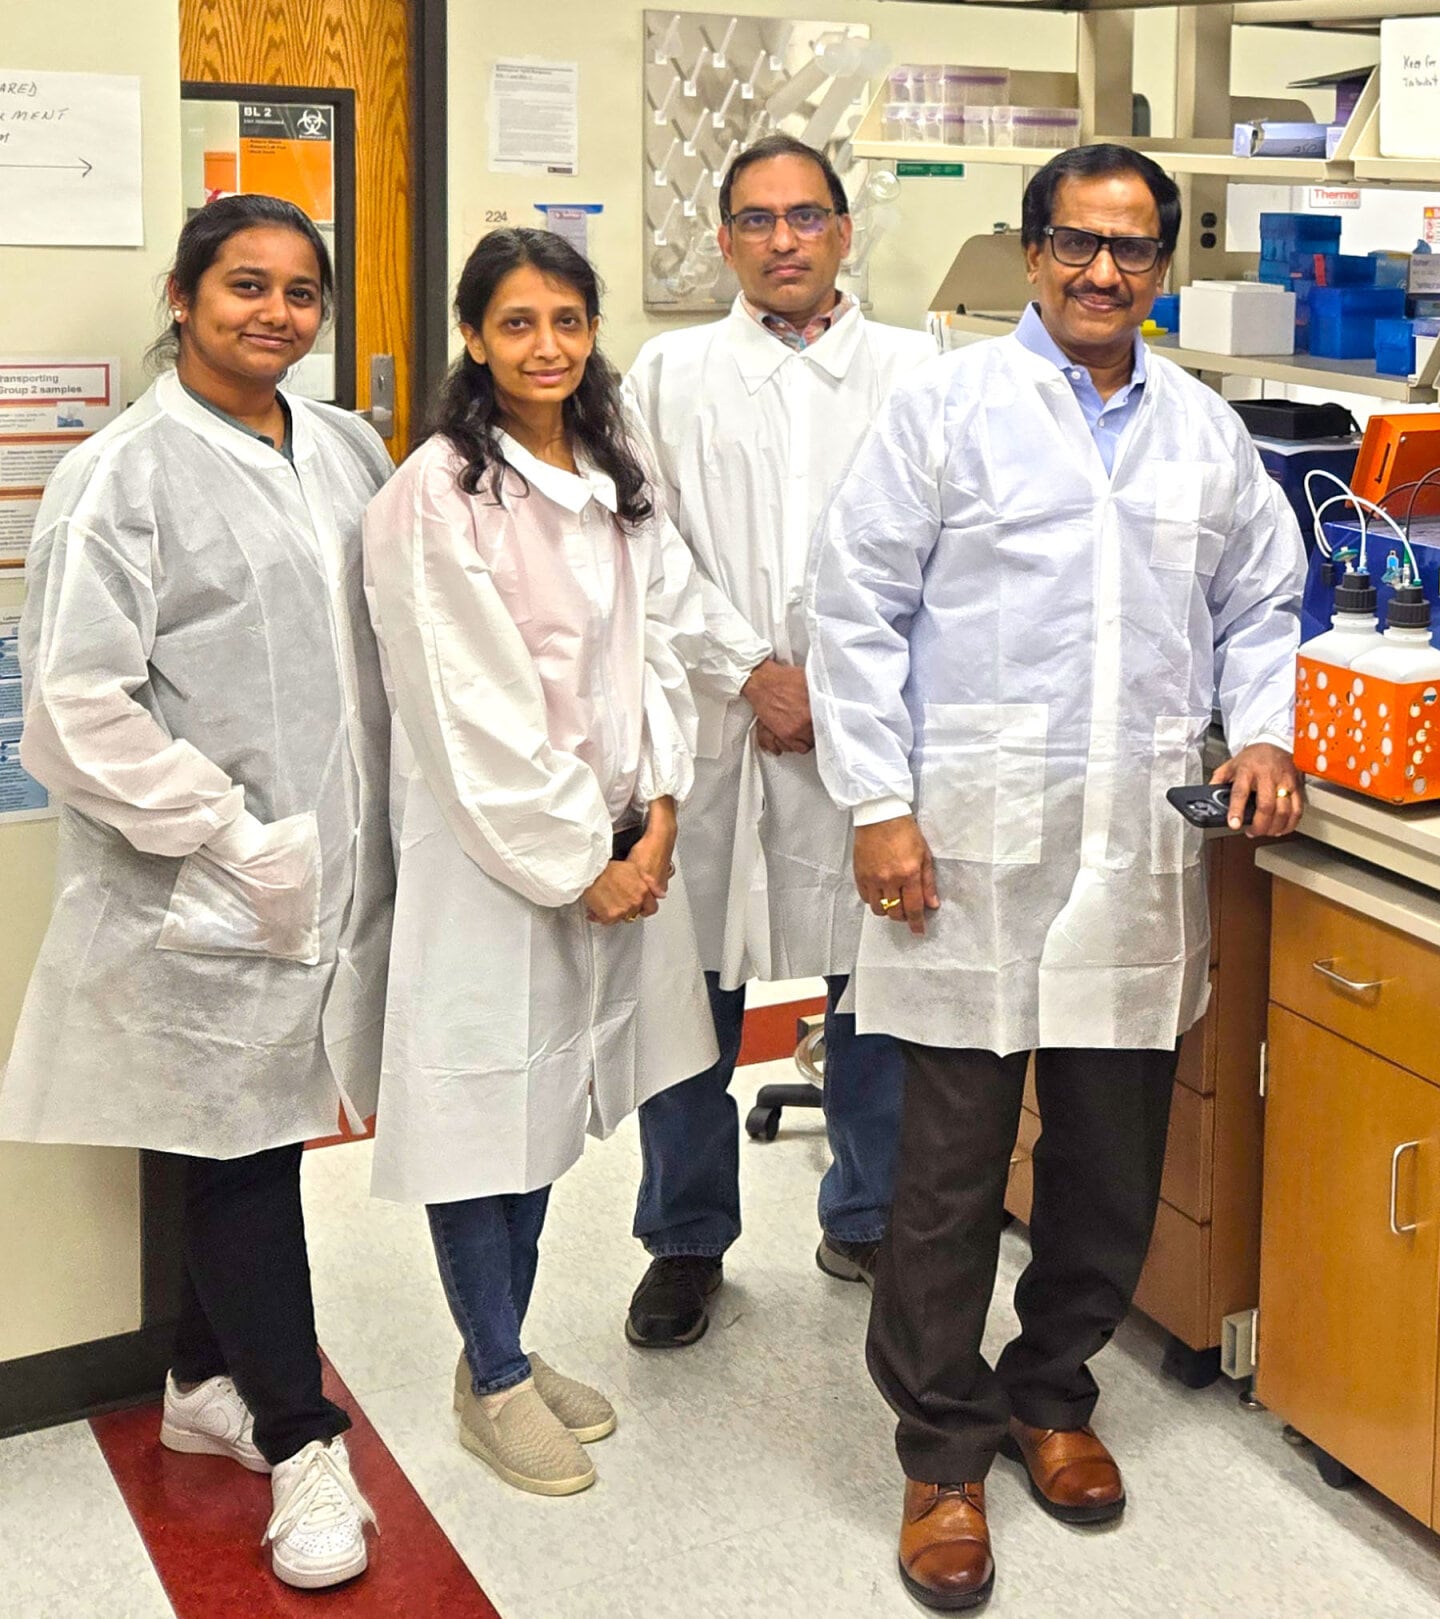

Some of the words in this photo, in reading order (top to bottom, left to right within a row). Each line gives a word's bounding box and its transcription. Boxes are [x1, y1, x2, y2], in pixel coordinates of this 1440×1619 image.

[243, 106, 261, 117] BL
[263, 107, 272, 117] 2
[1313, 188, 1359, 200] Thermo
[485, 211, 508, 223] 224
[31, 386, 38, 394] 2
[40, 385, 82, 395] samples
